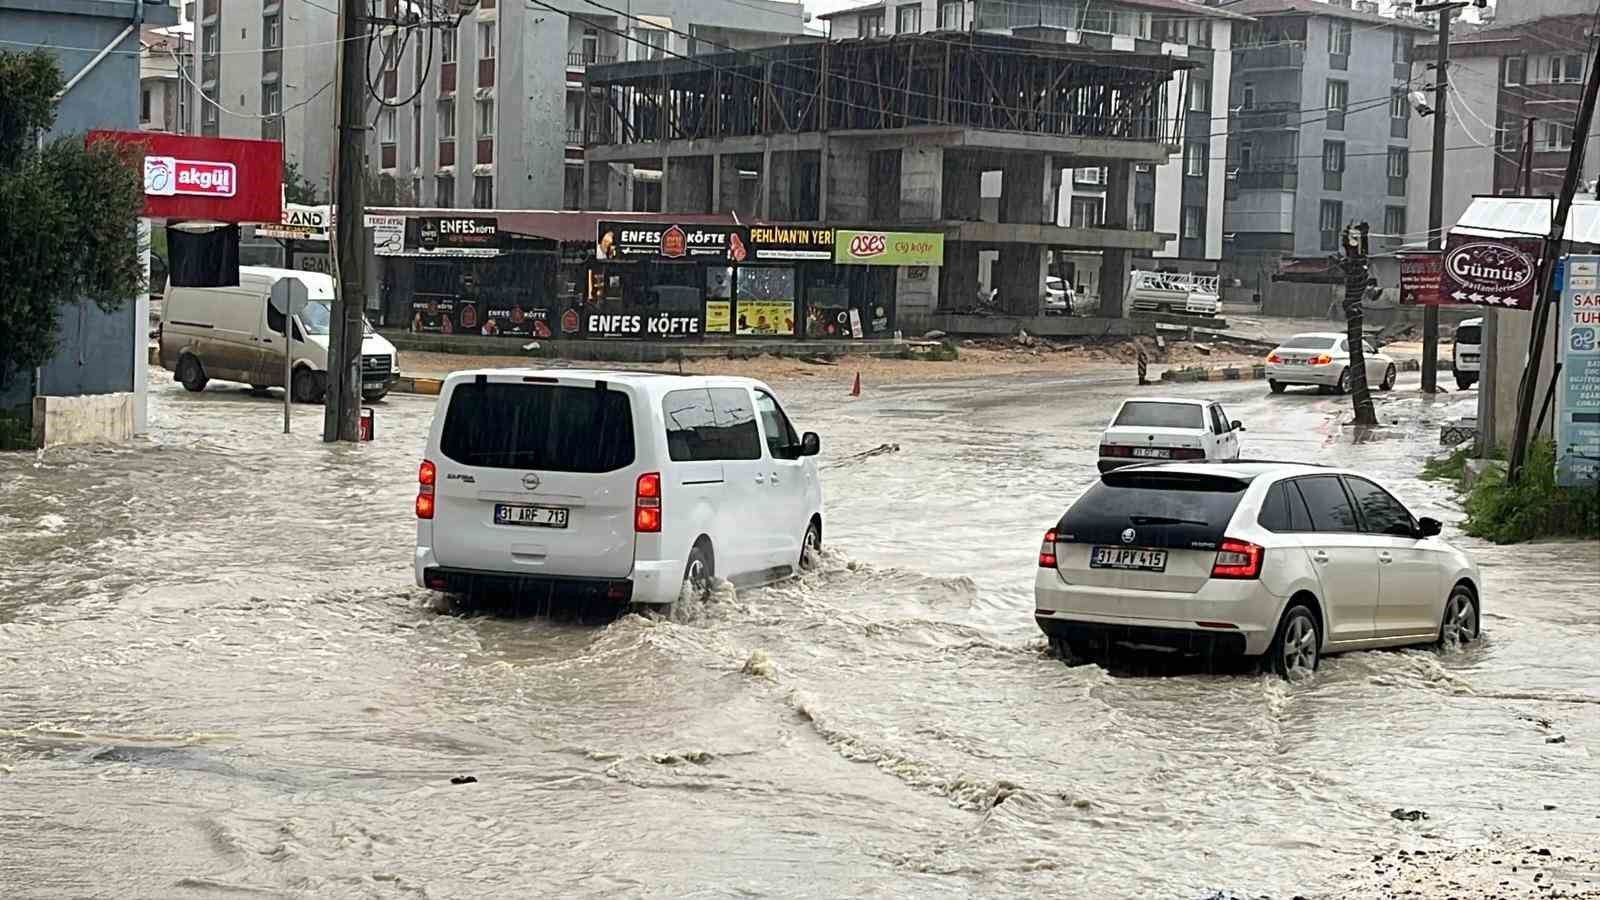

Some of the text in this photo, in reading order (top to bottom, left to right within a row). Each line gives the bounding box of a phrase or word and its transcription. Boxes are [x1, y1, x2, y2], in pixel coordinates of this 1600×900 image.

[179, 168, 230, 188] akgül
[440, 219, 475, 234] ENFES
[621, 230, 661, 243] ENFES
[687, 230, 725, 244] KÖFTE
[750, 226, 835, 244] PEHLİVAN'IN YERİ
[588, 315, 641, 332] ENFES
[647, 312, 699, 333] KÖFTE
[501, 507, 565, 523] 31 ARF 713
[1099, 550, 1112, 563] 31
[1140, 552, 1162, 566] 415
